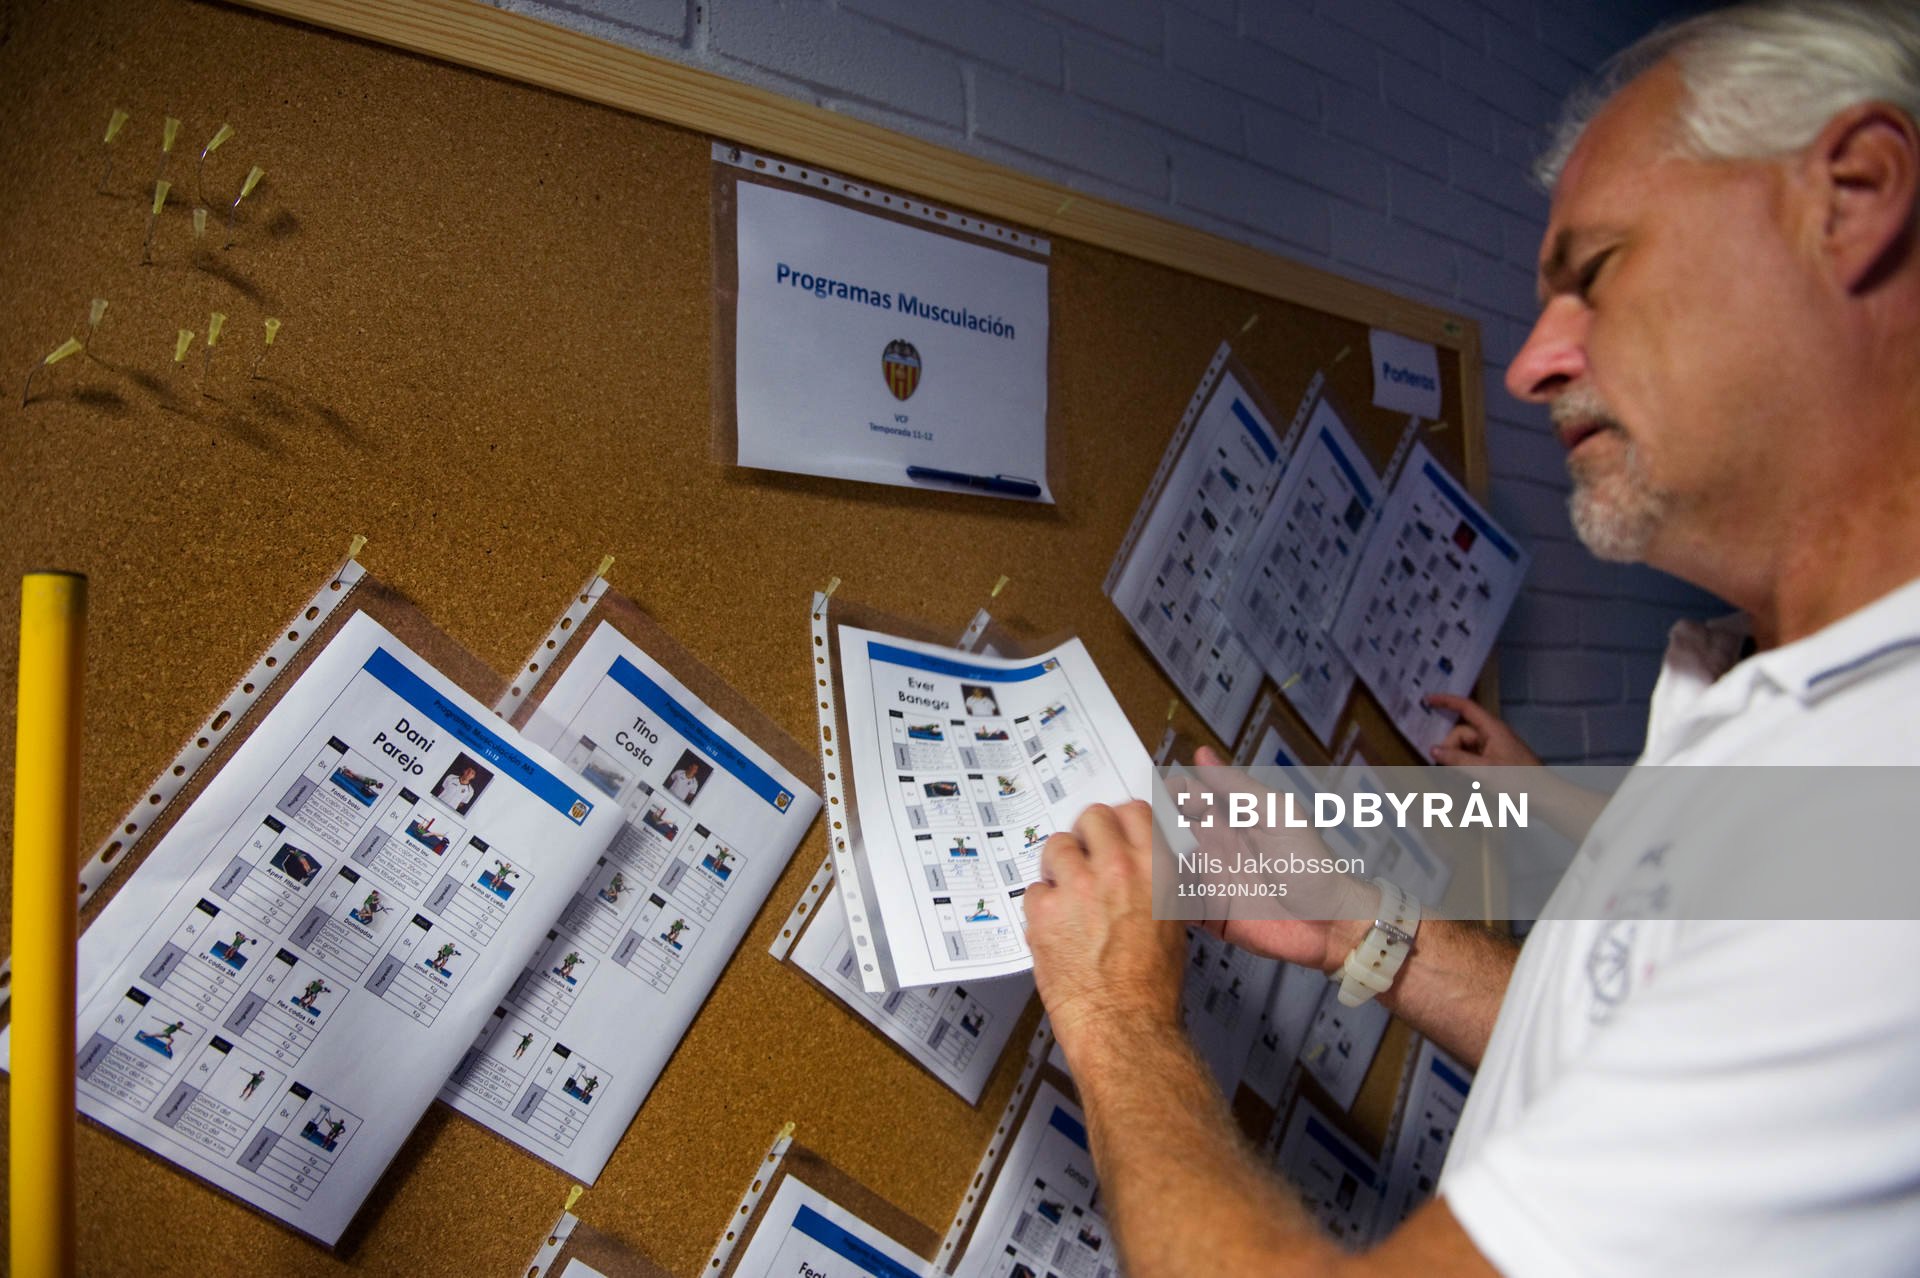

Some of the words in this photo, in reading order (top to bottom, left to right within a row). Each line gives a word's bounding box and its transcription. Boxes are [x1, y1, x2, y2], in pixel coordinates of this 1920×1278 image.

[776, 262, 892, 310] Programas
[897, 293, 1015, 340] Musculación
[894, 413, 908, 424] VCF
[868, 422, 911, 438] Temporada
[912, 430, 933, 441] 11-12
[908, 677, 935, 692] Ever
[898, 691, 949, 711] Banega
[394, 718, 436, 753] Dani
[632, 717, 658, 744] Tino
[372, 732, 424, 776] Parejo
[615, 731, 653, 768] Costa
[343, 918, 373, 939] Dominadas
